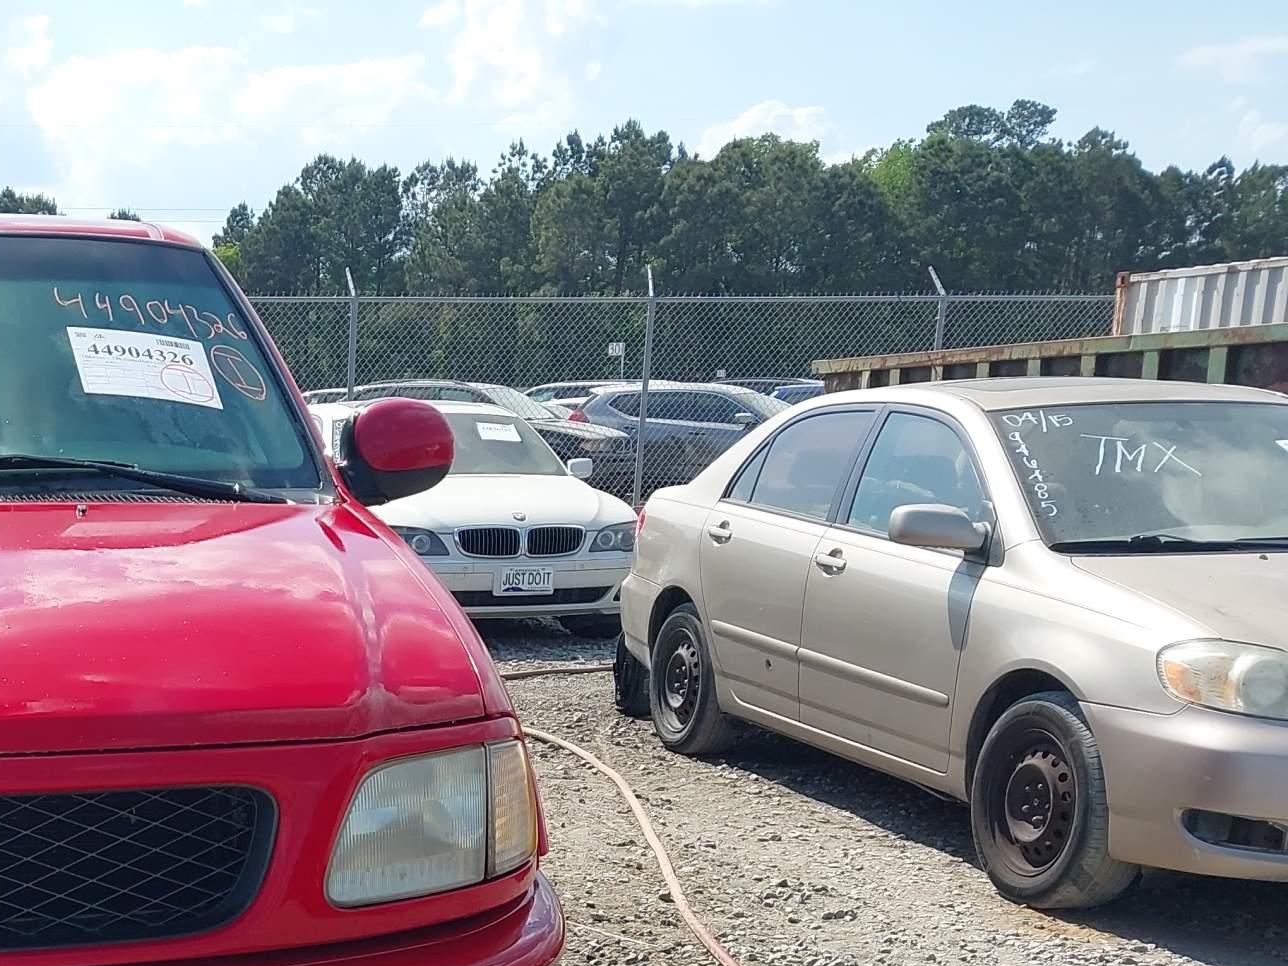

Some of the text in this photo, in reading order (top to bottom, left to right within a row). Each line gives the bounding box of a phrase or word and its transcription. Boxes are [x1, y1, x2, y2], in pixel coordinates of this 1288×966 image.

[54, 287, 248, 340] 44904326
[87, 343, 194, 366] 44904326
[1002, 410, 1073, 433] 04/15
[1080, 433, 1203, 476] TMX
[502, 572, 526, 586] JUST
